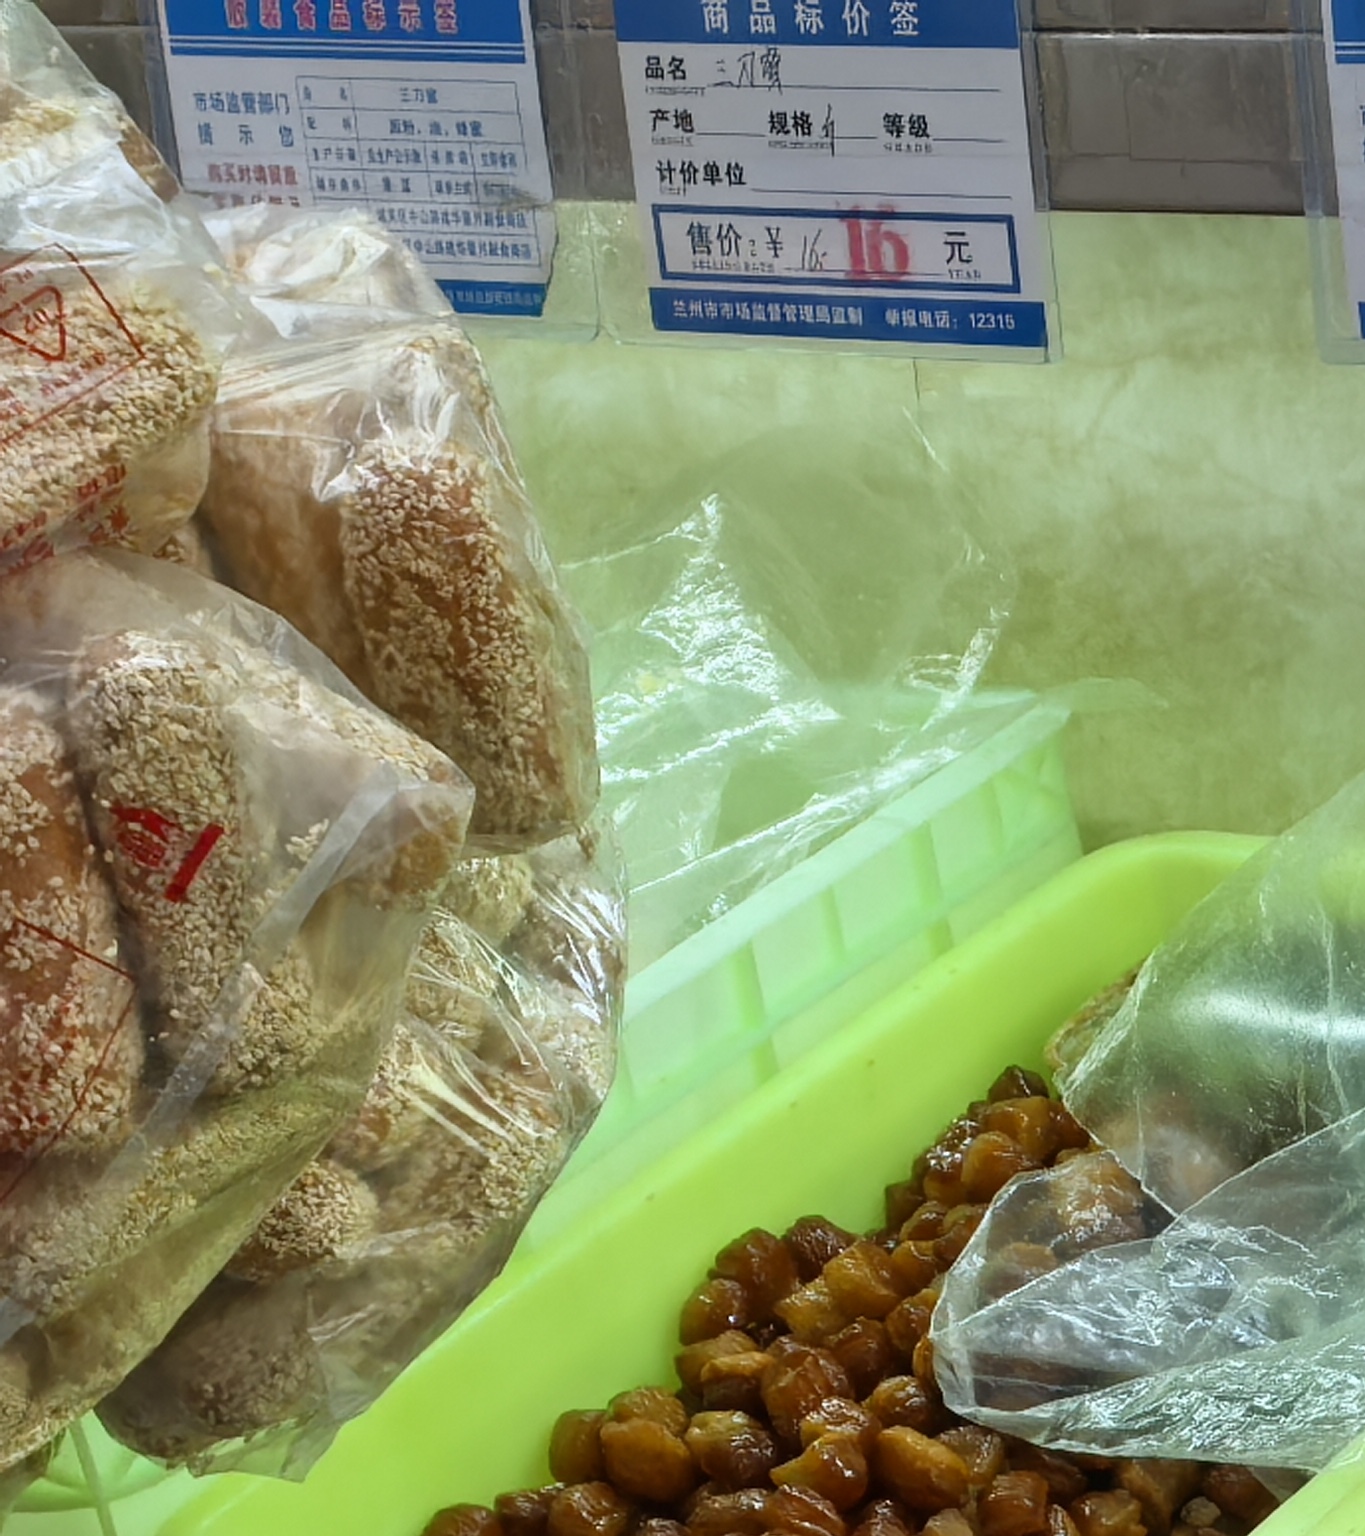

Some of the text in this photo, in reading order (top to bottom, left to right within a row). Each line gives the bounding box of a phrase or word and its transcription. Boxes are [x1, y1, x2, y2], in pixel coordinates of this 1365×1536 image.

[703, 0, 920, 37] 商品标价签
[645, 56, 686, 81] 品名
[650, 108, 695, 134] 产地
[768, 110, 813, 137] 规格
[883, 112, 931, 139] 等级
[655, 158, 747, 187] 计价单位
[943, 231, 973, 266] 元
[968, 311, 1017, 330] 12315
